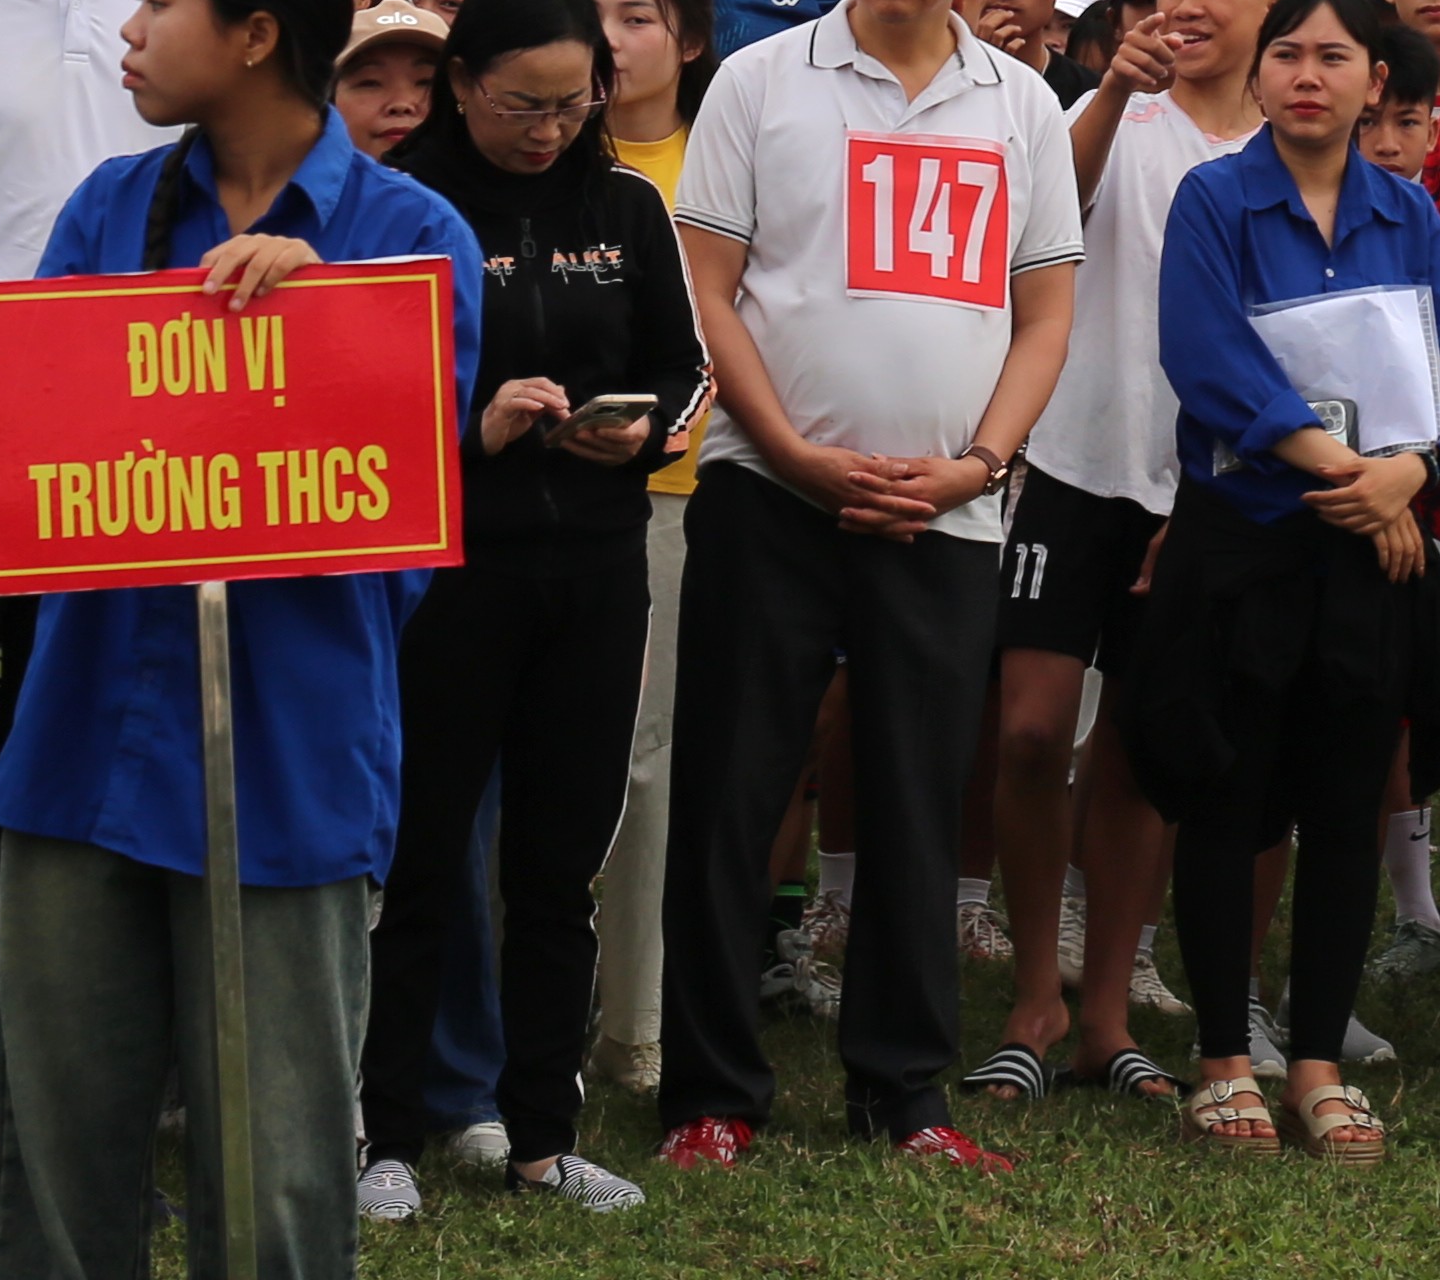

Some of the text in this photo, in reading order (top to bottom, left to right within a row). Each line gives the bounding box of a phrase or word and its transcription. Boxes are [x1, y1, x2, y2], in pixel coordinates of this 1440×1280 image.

[376, 11, 418, 26] alo
[861, 153, 1000, 285] 147
[126, 313, 286, 407] ĐƠN VỊ
[28, 438, 391, 539] TRƯỜNG THCS
[1011, 543, 1048, 599] 11
